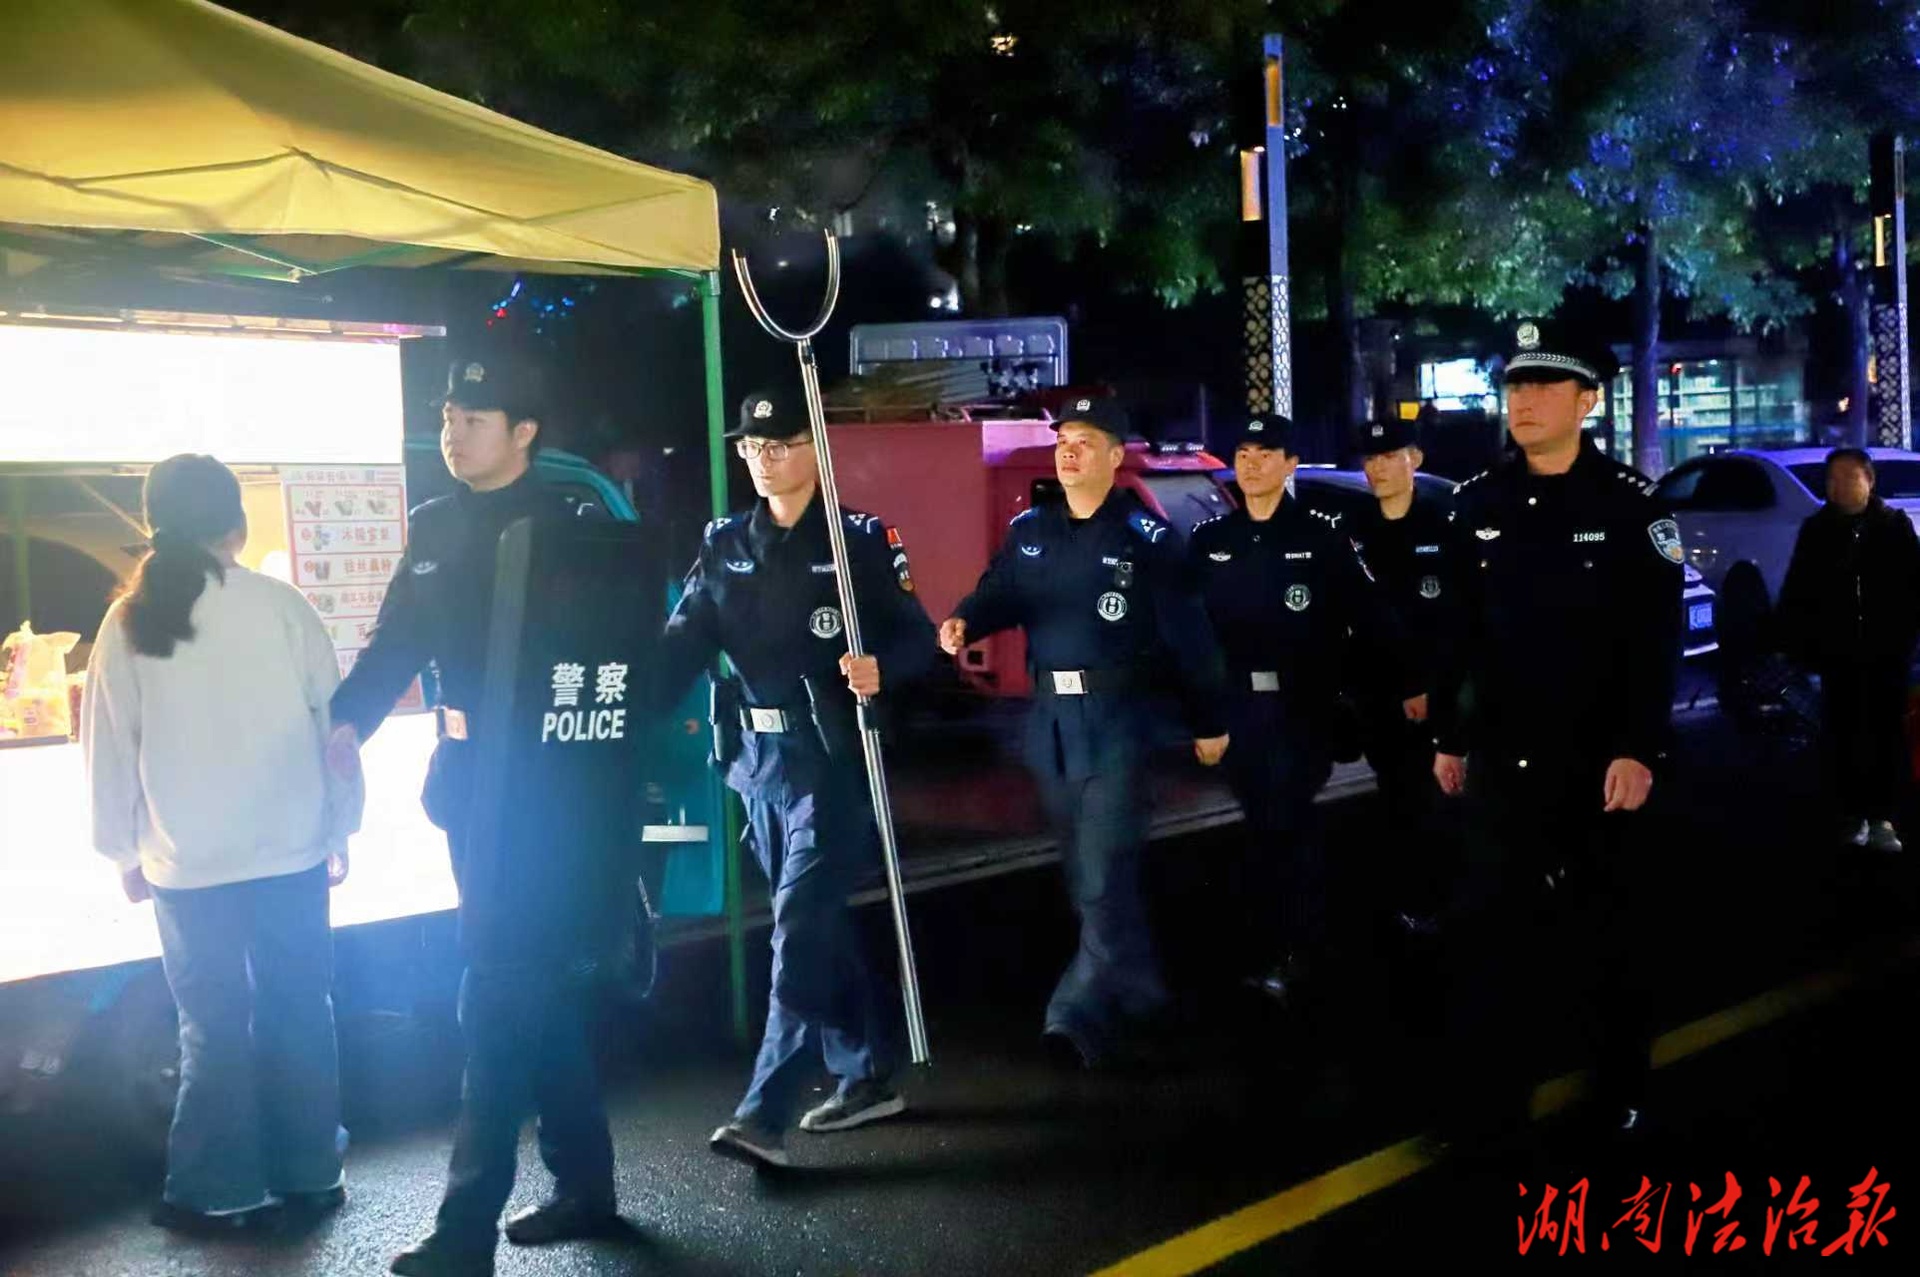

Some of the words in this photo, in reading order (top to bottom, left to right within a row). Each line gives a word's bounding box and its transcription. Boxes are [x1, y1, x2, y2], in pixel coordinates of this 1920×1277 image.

[1573, 532, 1606, 543] 114095
[551, 662, 628, 706] 警察
[542, 709, 626, 742] POLICE
